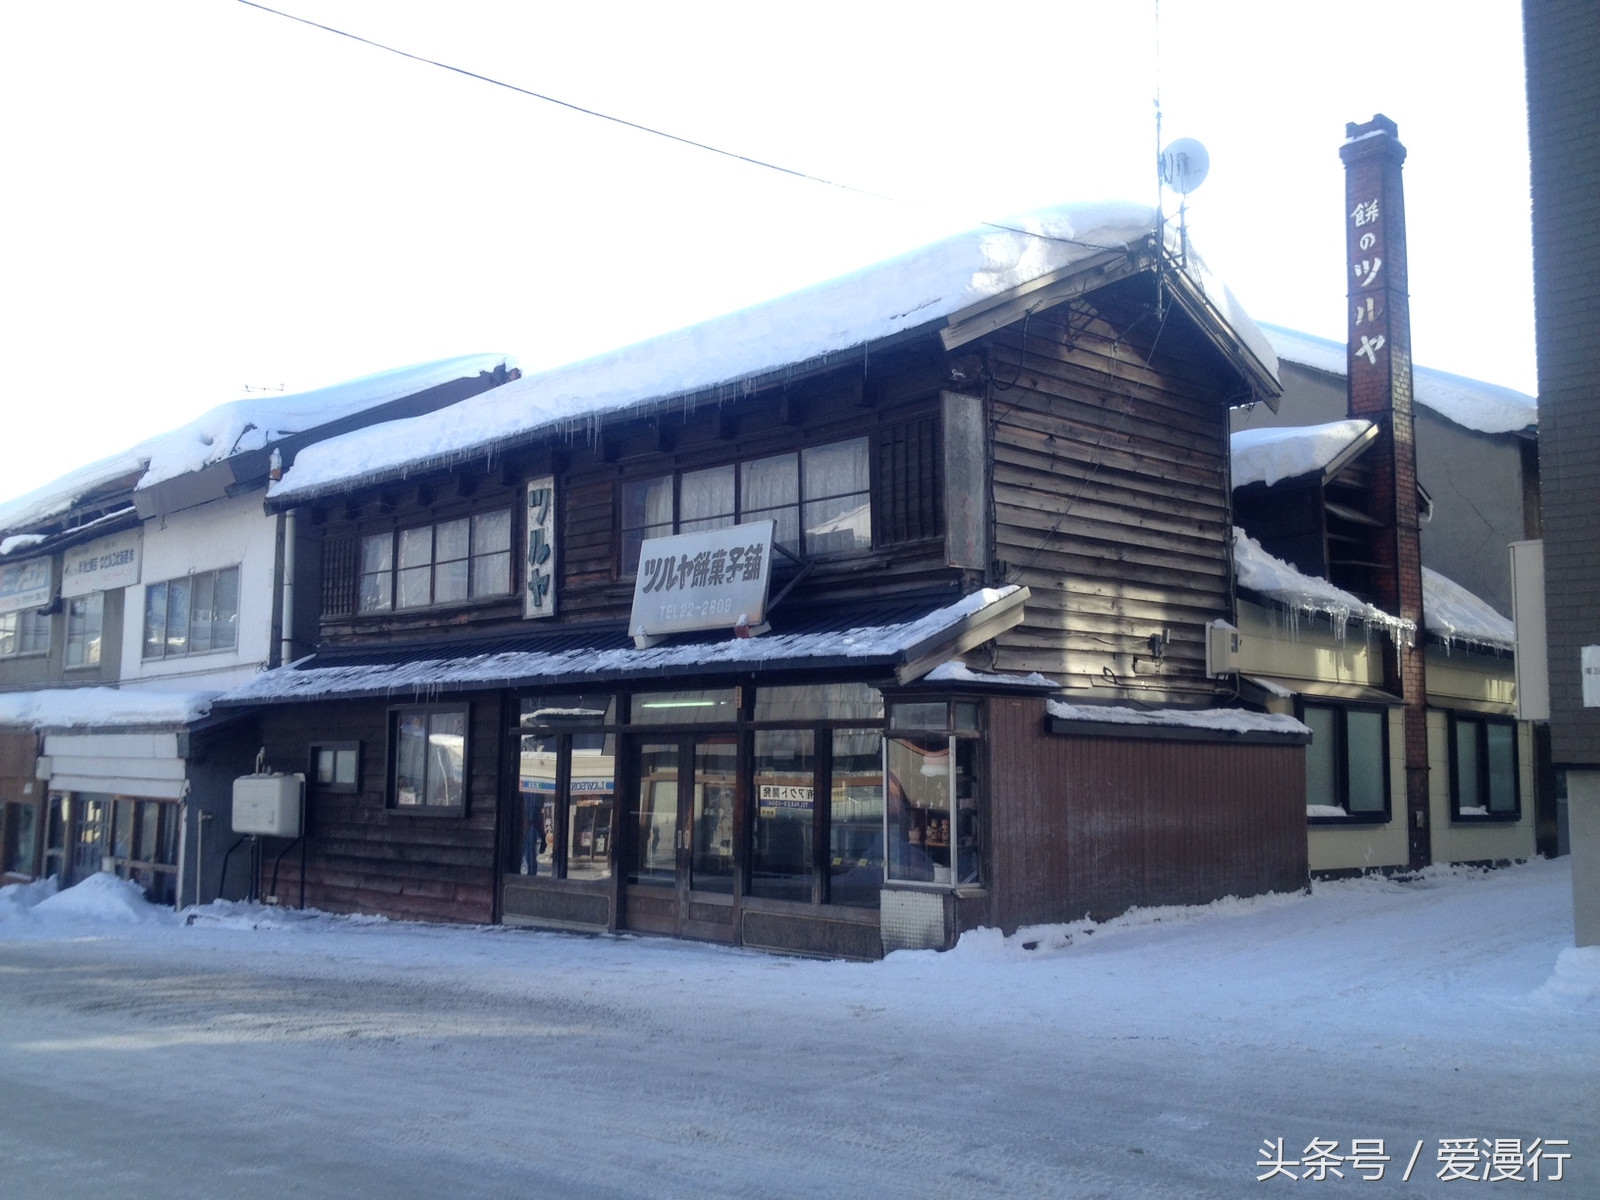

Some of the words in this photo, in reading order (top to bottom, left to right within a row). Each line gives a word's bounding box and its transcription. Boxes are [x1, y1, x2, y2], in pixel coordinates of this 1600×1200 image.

[527, 488, 552, 607] ツルヤ
[642, 543, 764, 594] ツルヤ餅菓子舗
